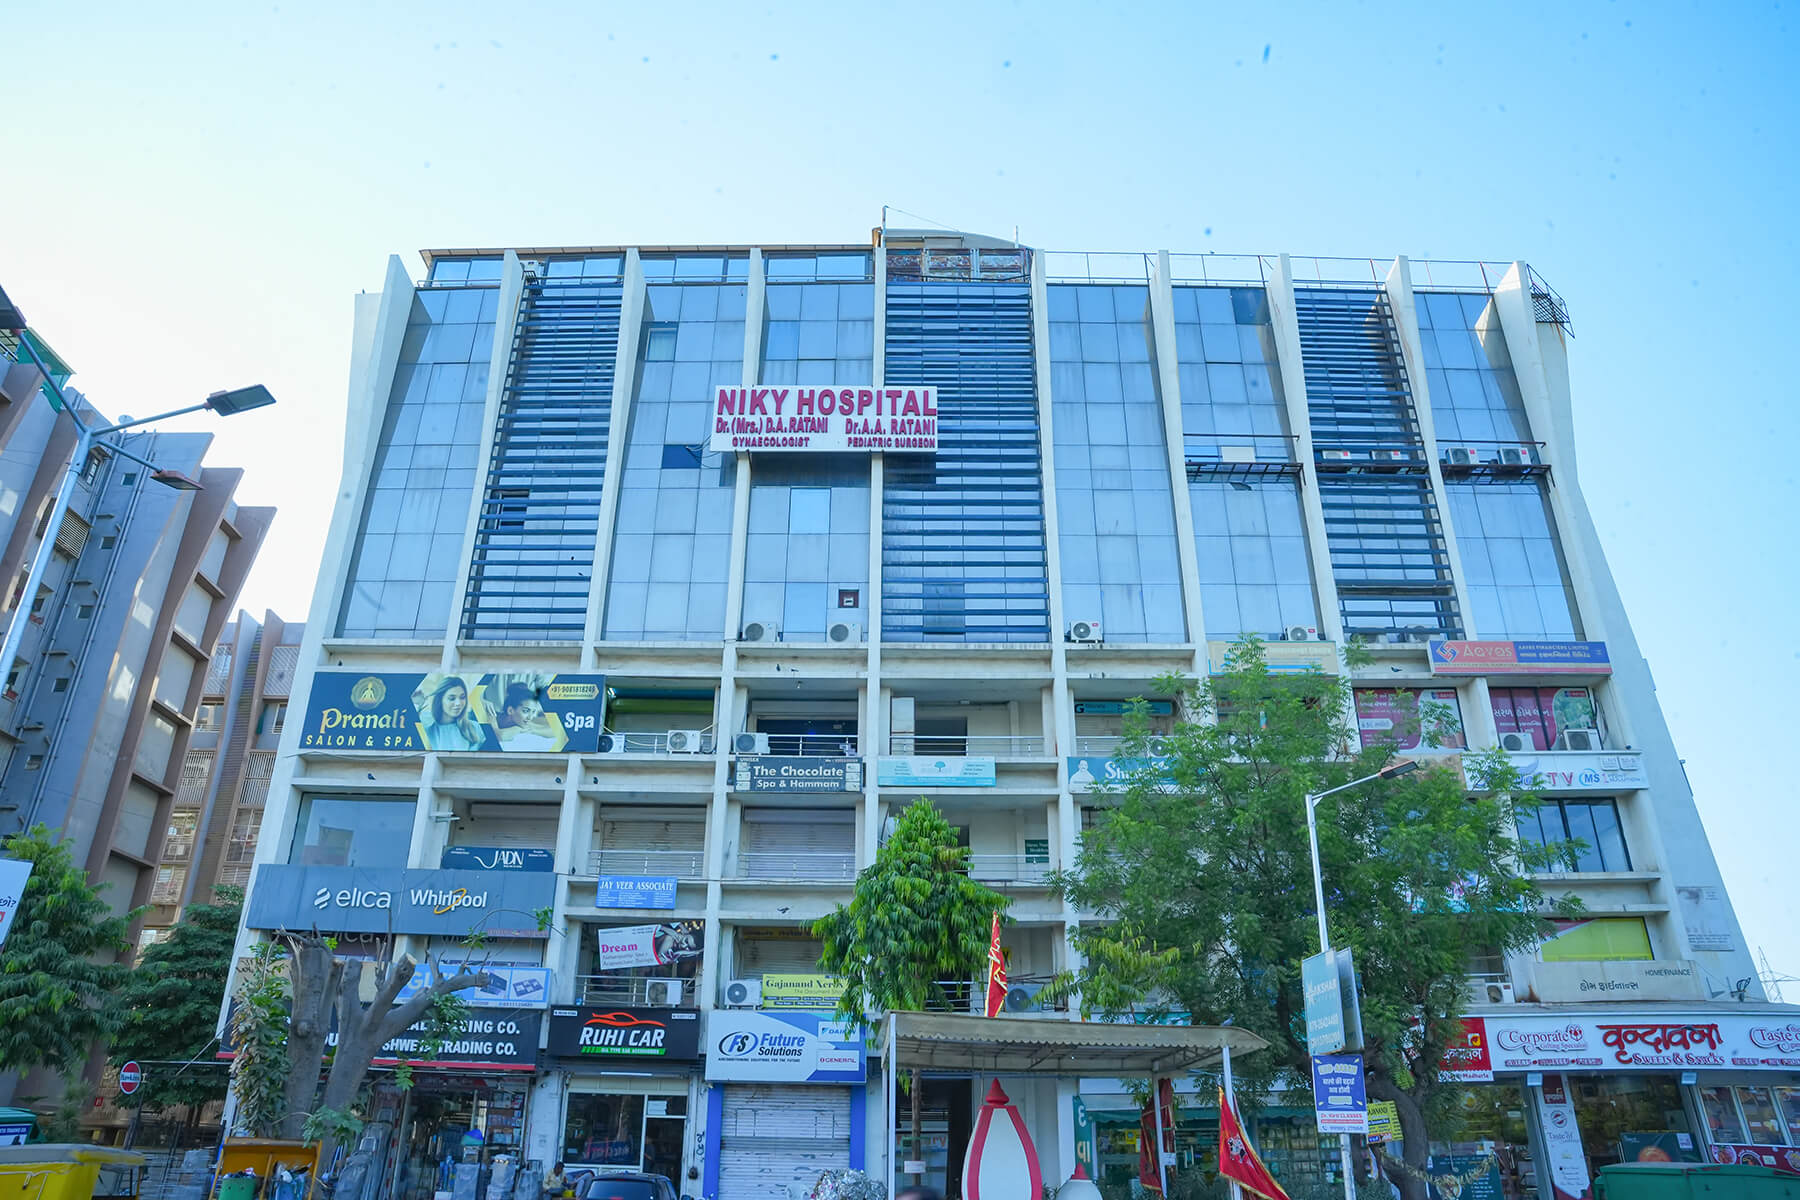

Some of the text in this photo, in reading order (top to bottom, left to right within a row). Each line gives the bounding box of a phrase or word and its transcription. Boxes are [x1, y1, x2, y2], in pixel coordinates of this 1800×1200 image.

[717, 389, 937, 417] NIKY HOSPITAL
[789, 416, 828, 434] RATANI
[891, 418, 935, 435] RATANI
[732, 437, 810, 447] GYNAECOLOGIST
[847, 436, 936, 448] PEDIATRIC SURGEON
[1463, 645, 1512, 657] Aavas
[321, 708, 406, 734] Pranali
[564, 712, 595, 732] Spa
[306, 735, 413, 748] SALON & SPA
[753, 765, 844, 777] The Chocolate
[757, 780, 840, 789] Spa & Hammam
[600, 881, 673, 891] JAY VEER ASSOCIATE
[336, 888, 488, 911] elica Whirlpool
[601, 943, 638, 953] Dream
[766, 979, 813, 989] Gajanand
[497, 1021, 521, 1034] CO.
[579, 1027, 665, 1047] RUHI CAR
[760, 1033, 806, 1047] Future
[1509, 1030, 1569, 1046] Corporate
[1760, 1028, 1792, 1042] Taste
[438, 1040, 494, 1054] TRADING
[495, 1042, 518, 1055] CO.
[758, 1046, 802, 1057] Solutions
[1673, 1052, 1684, 1065] &
